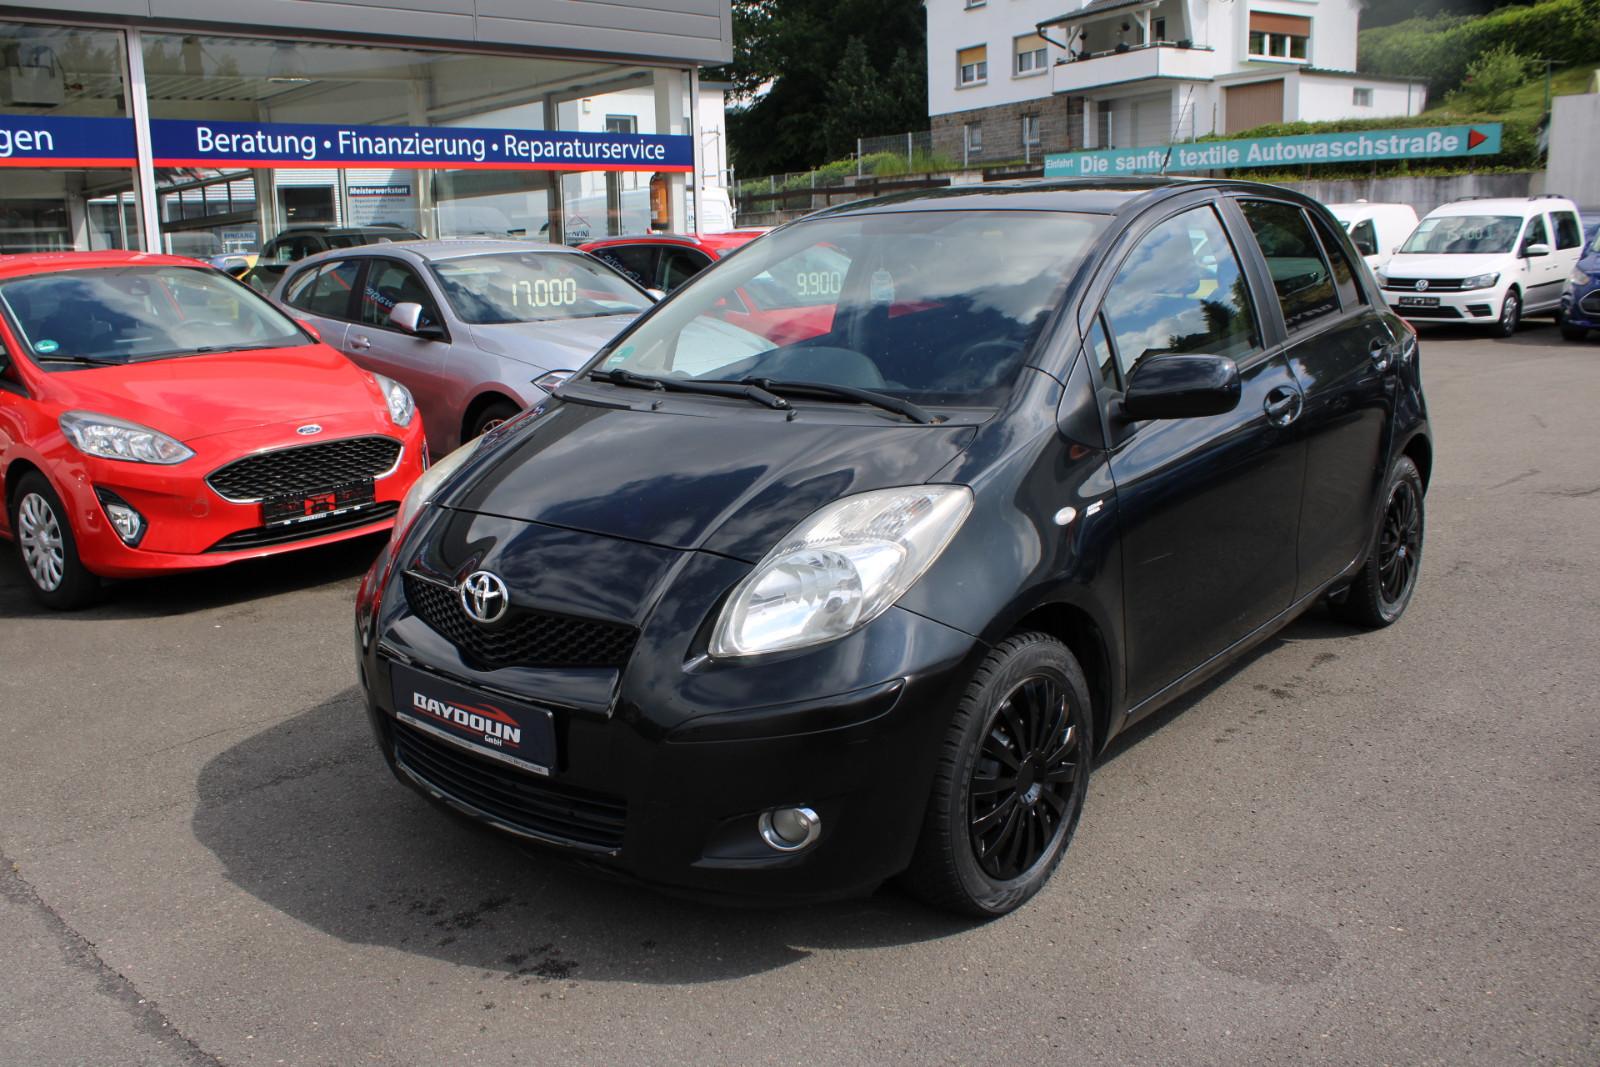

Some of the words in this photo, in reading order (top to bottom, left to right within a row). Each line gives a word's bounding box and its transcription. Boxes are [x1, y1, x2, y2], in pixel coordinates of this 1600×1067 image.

[197, 127, 316, 160] Beratung
[338, 131, 486, 162] Finanzierung
[504, 134, 665, 162] Reparaturservice
[1080, 155, 1108, 173] Die
[1179, 145, 1240, 166] textile
[1247, 131, 1459, 162] Autowaschstraße
[350, 186, 408, 195] Meisterwerkstatt
[511, 279, 577, 307] 17.000
[797, 271, 840, 295] 9.900
[413, 691, 521, 743] BAYDOUN
[484, 734, 502, 747] GmbH
